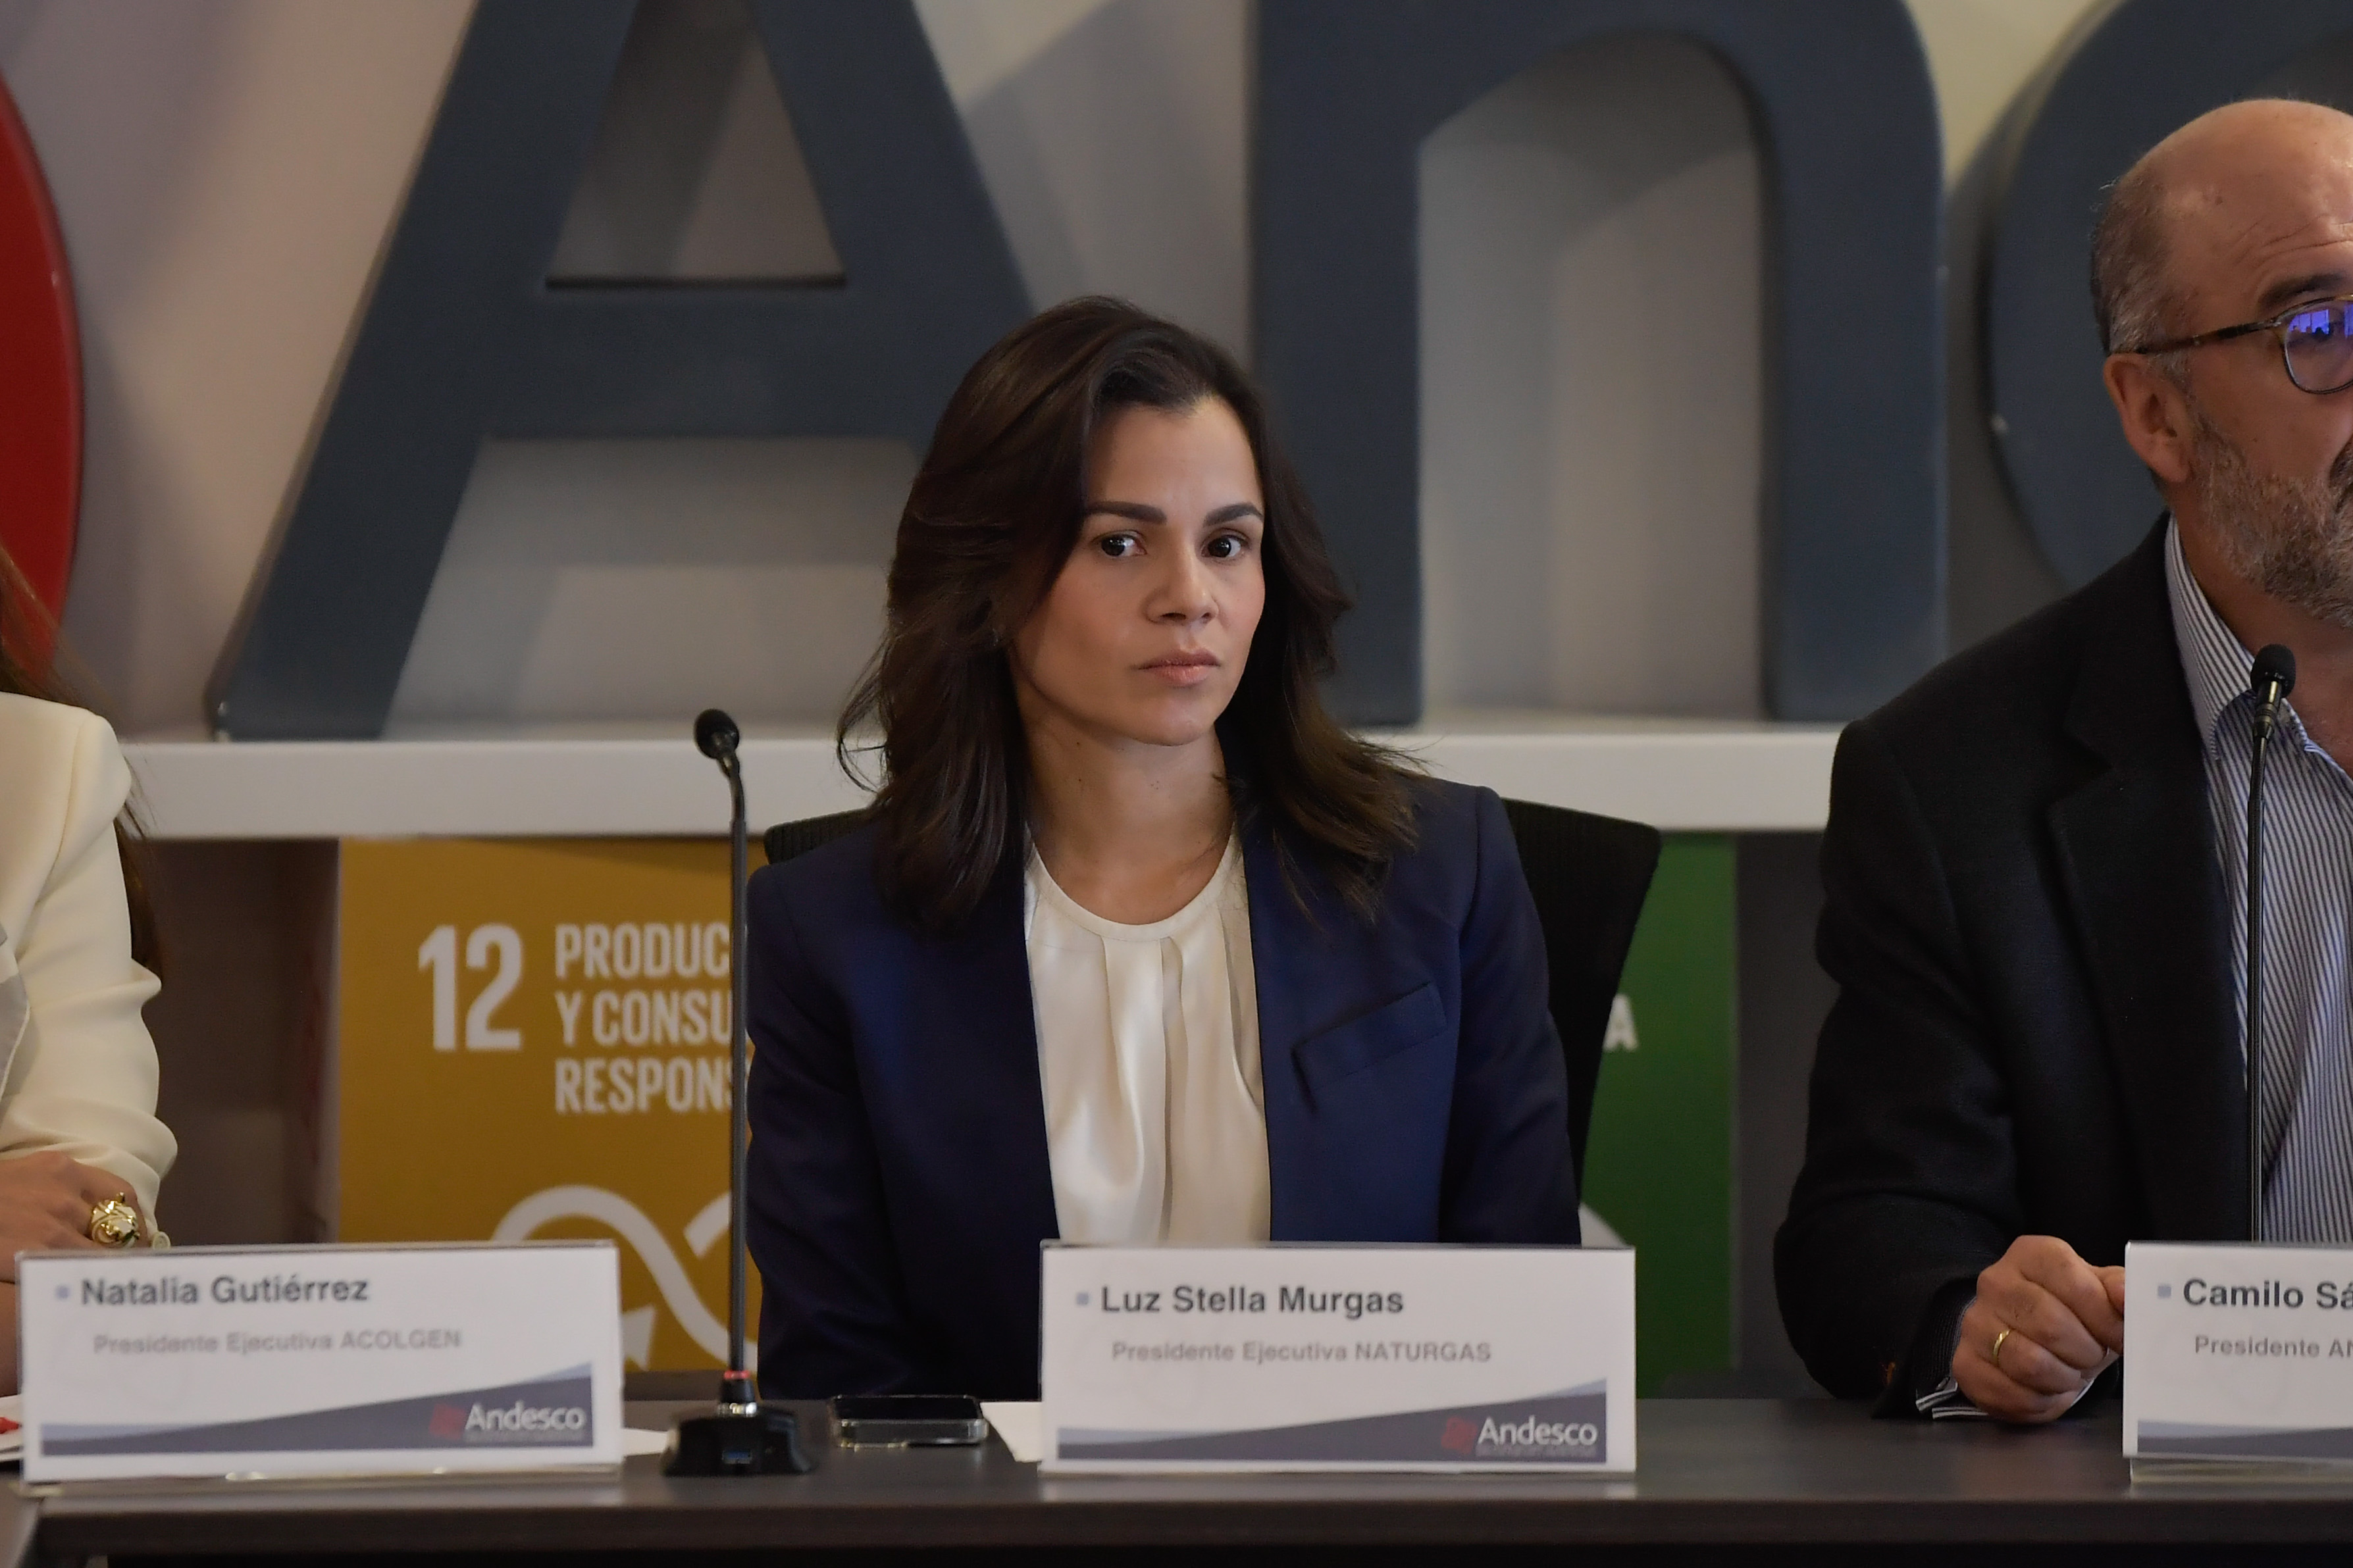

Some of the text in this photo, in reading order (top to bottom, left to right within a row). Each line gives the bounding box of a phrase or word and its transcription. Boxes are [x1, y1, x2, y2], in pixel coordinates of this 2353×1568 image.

[418, 924, 524, 1051] 12
[555, 992, 582, 1047] Y
[82, 1275, 370, 1305] Natalia Gutiérrez
[1101, 1285, 1405, 1319] Luz Stella Murgas
[2183, 1278, 2303, 1309] Camilo
[94, 1328, 462, 1355] Presidente Ejecutiva ACOLGEN
[1112, 1341, 1492, 1365] Presidente Ejecutiva NATURGAS
[2195, 1334, 2319, 1357] Presidente
[464, 1400, 587, 1432] Andesco
[1477, 1414, 1599, 1446] Andesco
